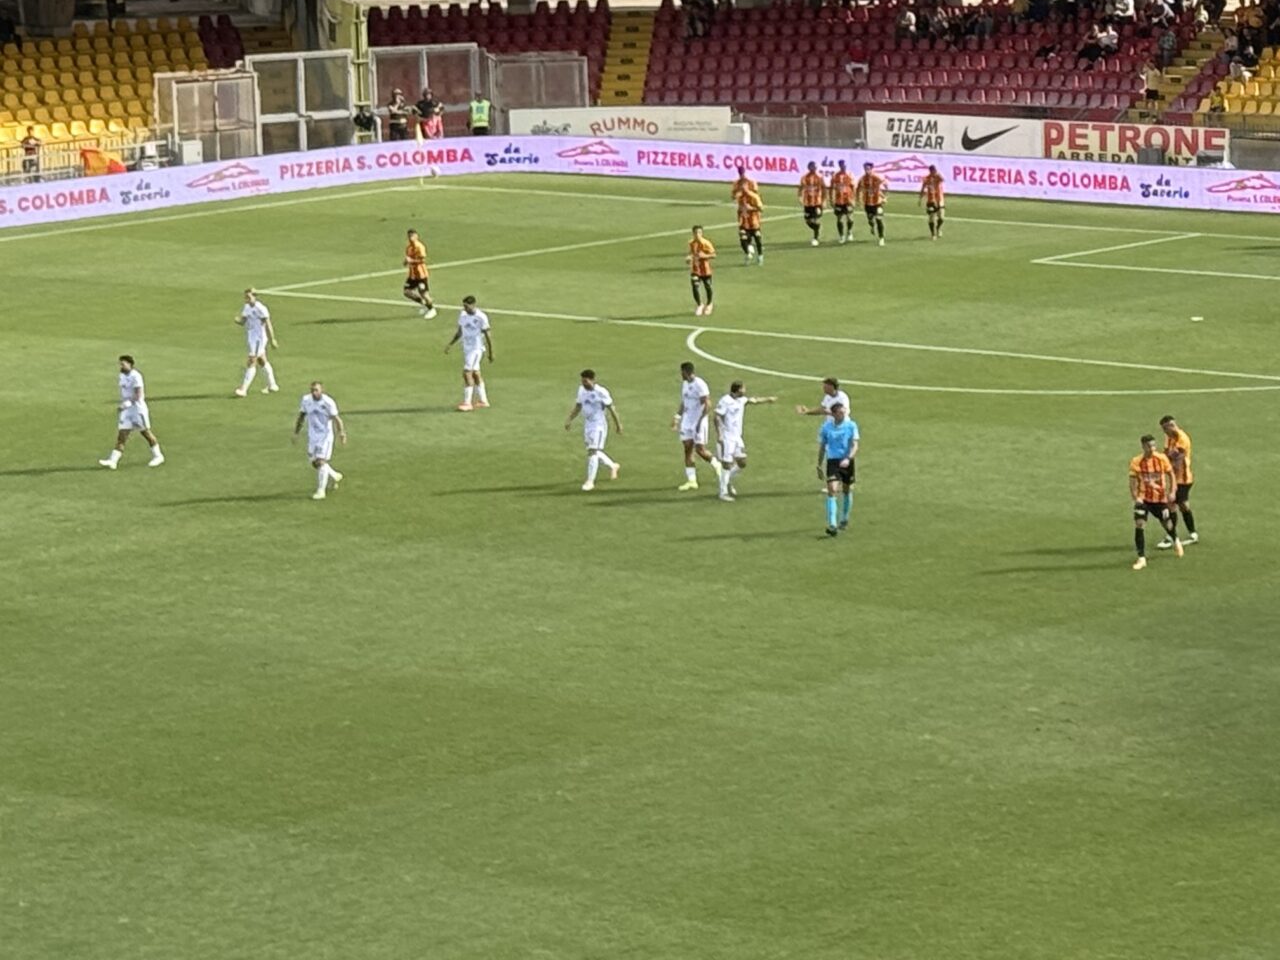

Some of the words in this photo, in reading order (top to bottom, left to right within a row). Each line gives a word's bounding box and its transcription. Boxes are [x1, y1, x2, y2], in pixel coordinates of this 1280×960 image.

[589, 117, 659, 137] RUMMO
[897, 118, 938, 134] TEAM
[504, 143, 520, 155] da
[901, 134, 945, 150] WEAR
[1043, 121, 1227, 159] PETRONE
[280, 157, 353, 180] PIZZERIA
[356, 155, 372, 170] S.
[376, 148, 474, 169] COLOMBA
[637, 150, 704, 169] PIZZERIA
[706, 152, 719, 169] S.
[723, 155, 800, 173] COLOMBA
[953, 165, 1026, 186] PIZZERIA
[1028, 170, 1043, 187] S.
[1047, 172, 1132, 192] COLOMBA
[1156, 174, 1171, 187] da
[17, 187, 111, 212] COLOMBA
